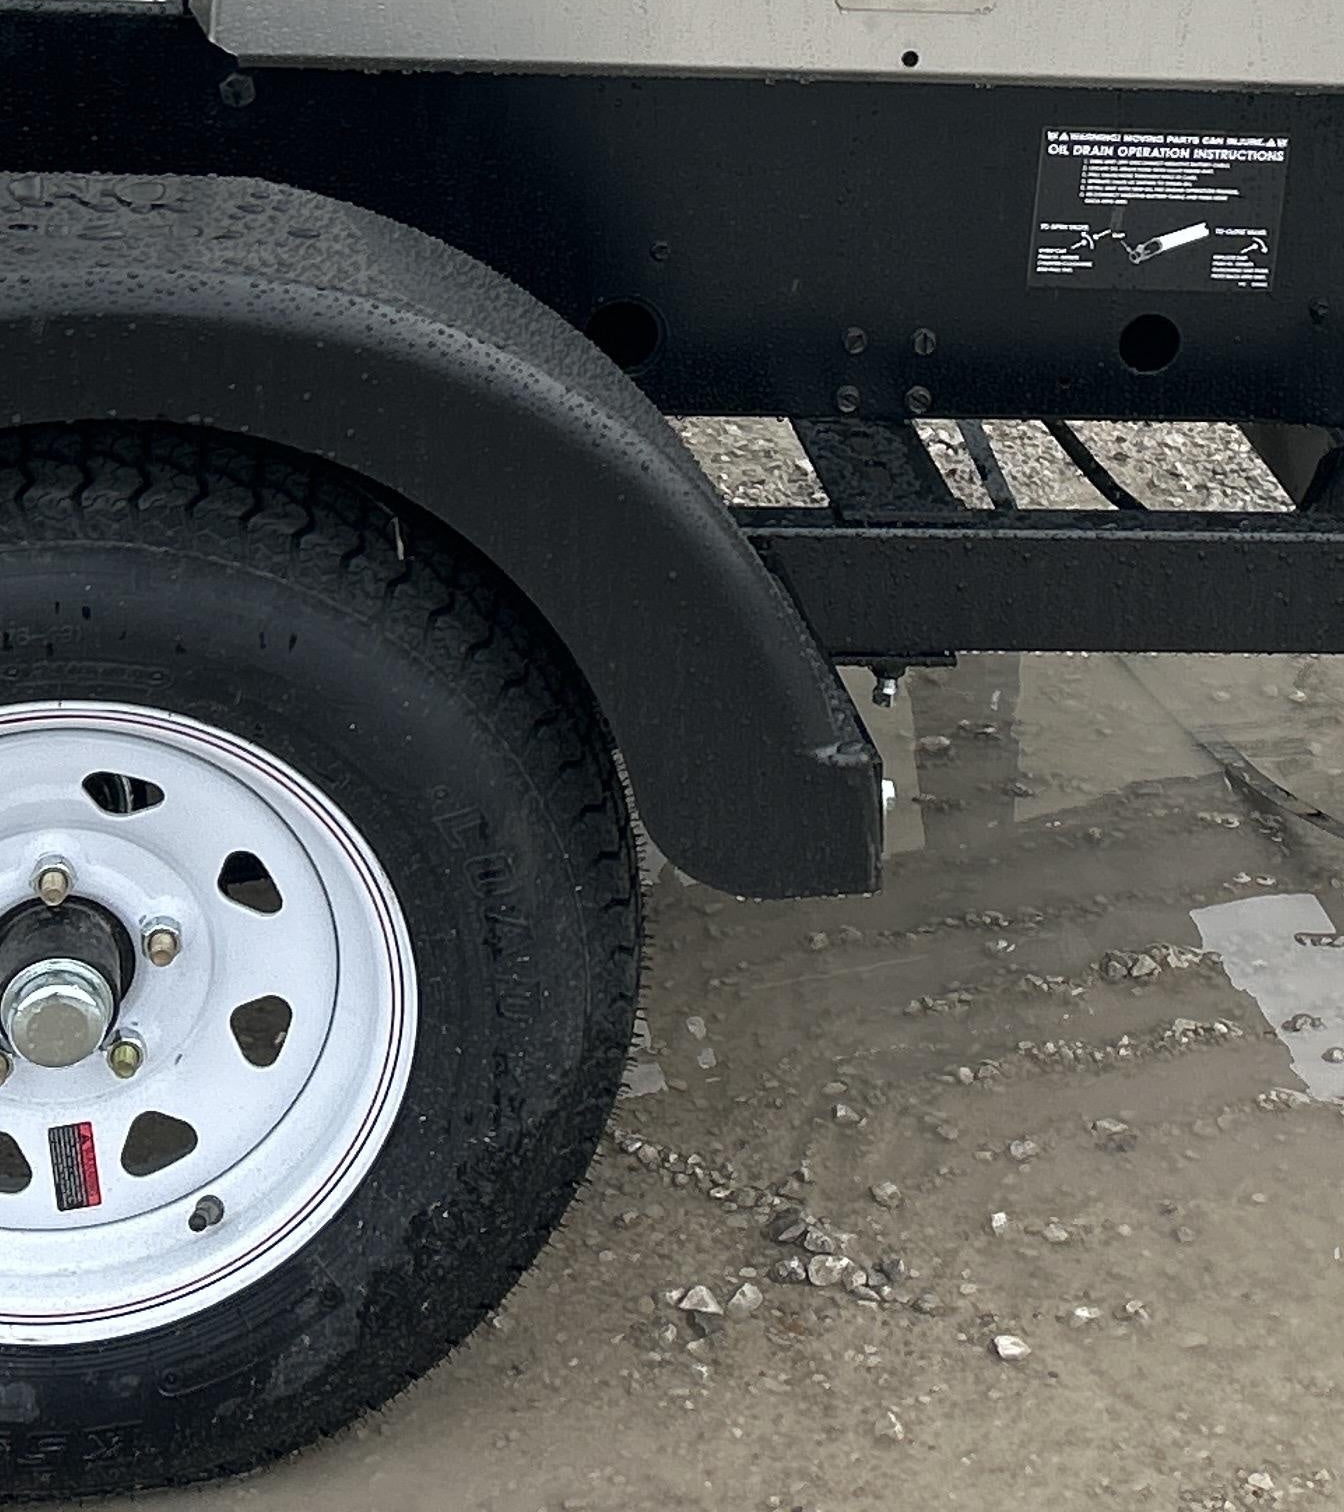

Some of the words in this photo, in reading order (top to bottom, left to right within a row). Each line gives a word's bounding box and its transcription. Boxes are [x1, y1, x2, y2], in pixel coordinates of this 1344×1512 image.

[1047, 143, 1070, 156] OIL
[1072, 145, 1114, 157] DRAIN
[1117, 146, 1190, 160] OPERATION
[1193, 148, 1285, 162] INSTRUCTIONS
